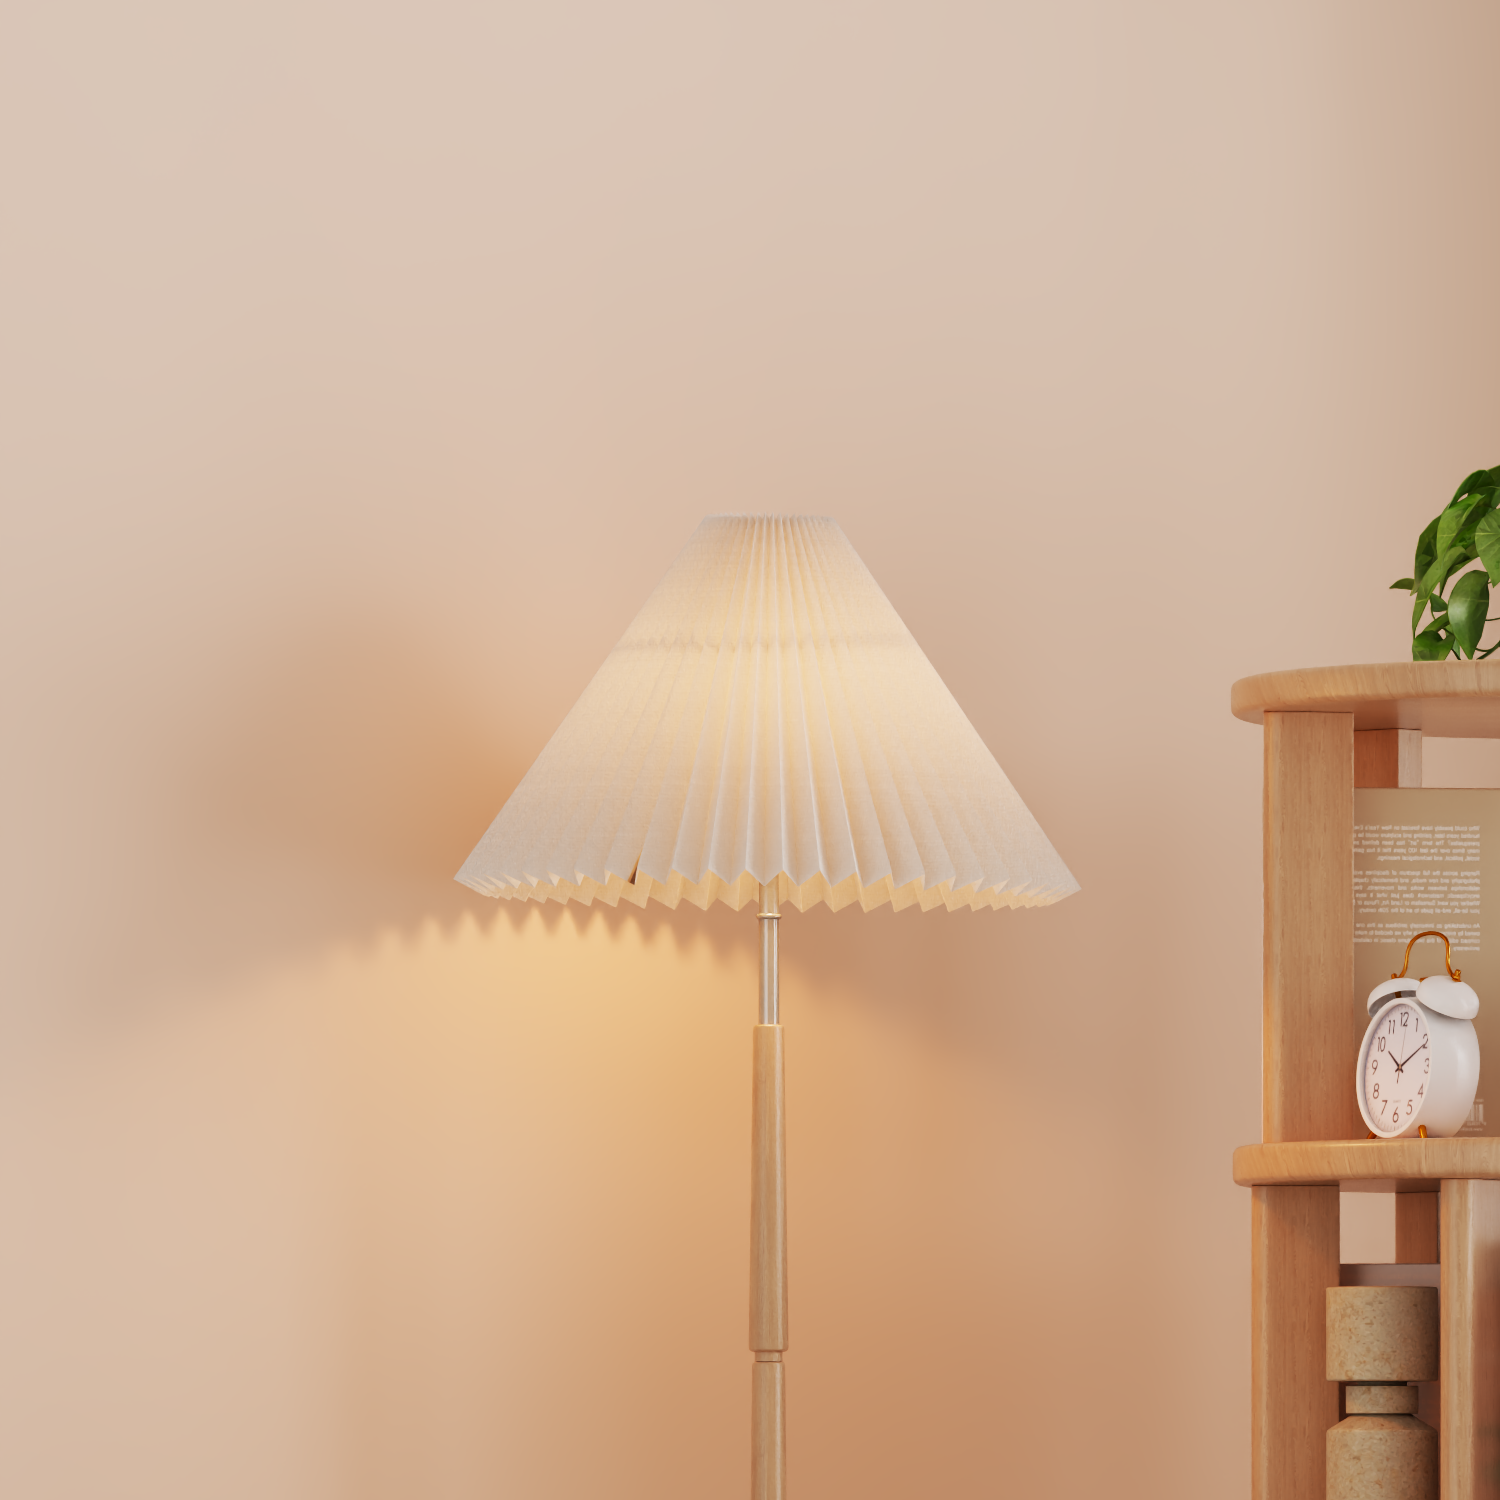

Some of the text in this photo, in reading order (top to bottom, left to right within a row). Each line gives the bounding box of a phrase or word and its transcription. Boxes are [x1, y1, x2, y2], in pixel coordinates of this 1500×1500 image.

[1388, 1019, 1396, 1034] 11
[1400, 1012, 1409, 1027] 12
[1415, 1018, 1419, 1032] 1
[1377, 1036, 1386, 1052] 10
[1422, 1033, 1429, 1049] 2
[1371, 1059, 1379, 1075] 9
[1424, 1058, 1429, 1074] 3
[1372, 1083, 1380, 1099] 8
[1417, 1083, 1424, 1098] 4
[1381, 1100, 1388, 1116] 7
[1392, 1107, 1399, 1123] 6
[1406, 1100, 1413, 1116] 5
